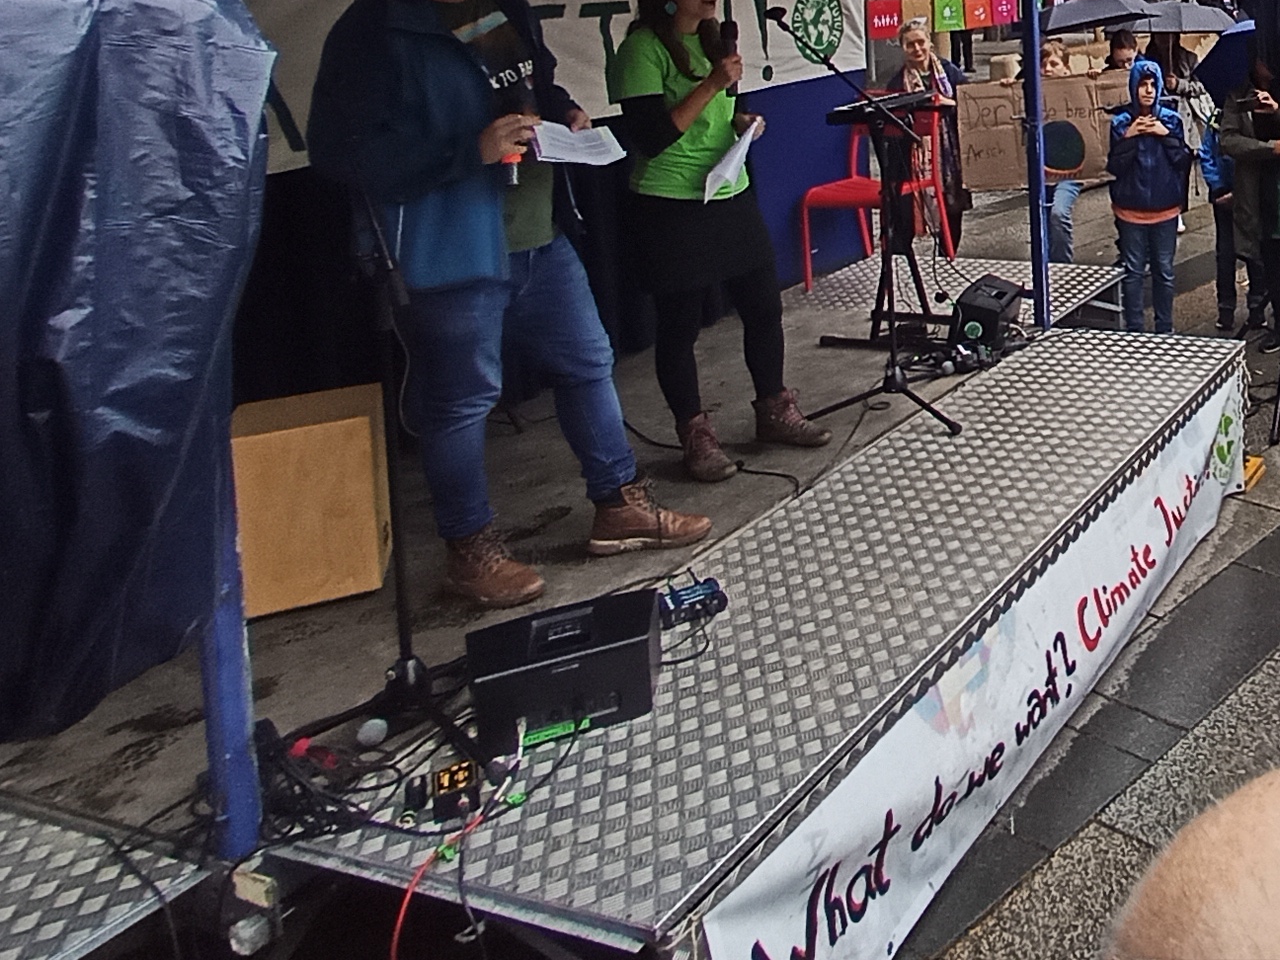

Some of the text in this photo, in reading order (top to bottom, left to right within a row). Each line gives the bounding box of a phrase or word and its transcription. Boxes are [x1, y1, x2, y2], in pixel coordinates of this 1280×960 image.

[830, 1, 841, 46] FUTURE
[962, 92, 1006, 131] Der
[966, 144, 1005, 165] Arsch
[911, 776, 957, 852] do
[957, 742, 1005, 805] we
[1015, 632, 1076, 746] want?
[1077, 544, 1156, 652] Climate
